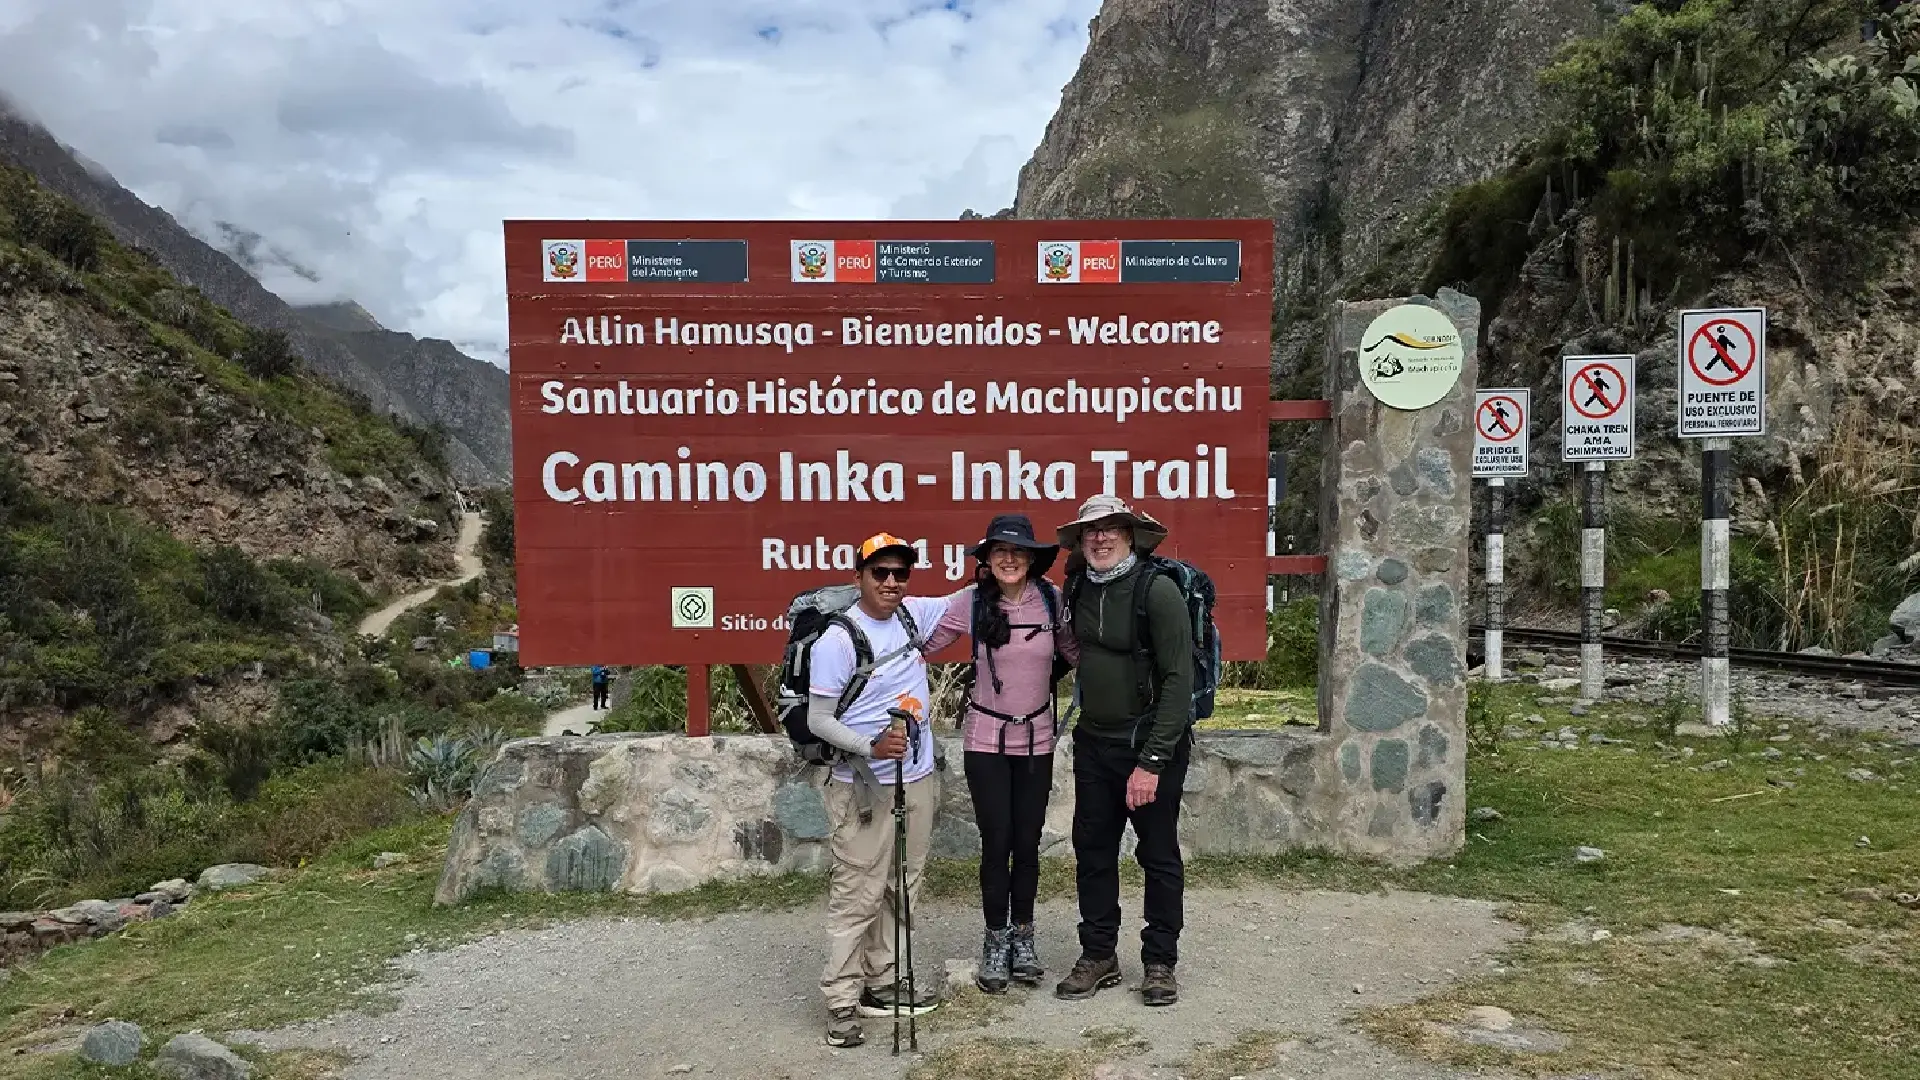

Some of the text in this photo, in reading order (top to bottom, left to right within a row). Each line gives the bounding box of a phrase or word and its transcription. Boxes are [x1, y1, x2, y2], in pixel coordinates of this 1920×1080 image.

[880, 244, 930, 255] Ministerio
[589, 253, 622, 269] PERÚ
[632, 255, 683, 266] Ministerio
[837, 253, 871, 270] PERÚ
[880, 255, 983, 267] de Comercio Exterior
[1083, 254, 1116, 270] PERÚ
[1125, 255, 1228, 267] Ministerio de Cultura
[632, 267, 698, 278] del Ambiente
[880, 268, 928, 279] y Turismo
[559, 315, 645, 345] Allin
[655, 317, 814, 353] Hamusqa
[842, 315, 1042, 345] Bienvenidos
[1067, 315, 1221, 345] Welcome
[541, 374, 1242, 423] Santuario Histórico de Machupicchu
[1687, 390, 1755, 403] PUENTE DE
[1685, 404, 1757, 417] USO EXCLUSIVO
[1567, 424, 1628, 434] CHAKA TREN
[1684, 419, 1716, 429] PERSONAL
[1583, 436, 1612, 445] AMA
[1479, 446, 1520, 455] BRIDGE
[1566, 446, 1628, 456] CHIMPAYCHU
[542, 446, 767, 502] Camino
[779, 449, 904, 502] Inka
[951, 449, 1076, 501] Inka
[1091, 443, 1236, 500] Trail
[762, 536, 862, 571] Ruta
[943, 544, 965, 581] y
[721, 613, 768, 631] Sitio
